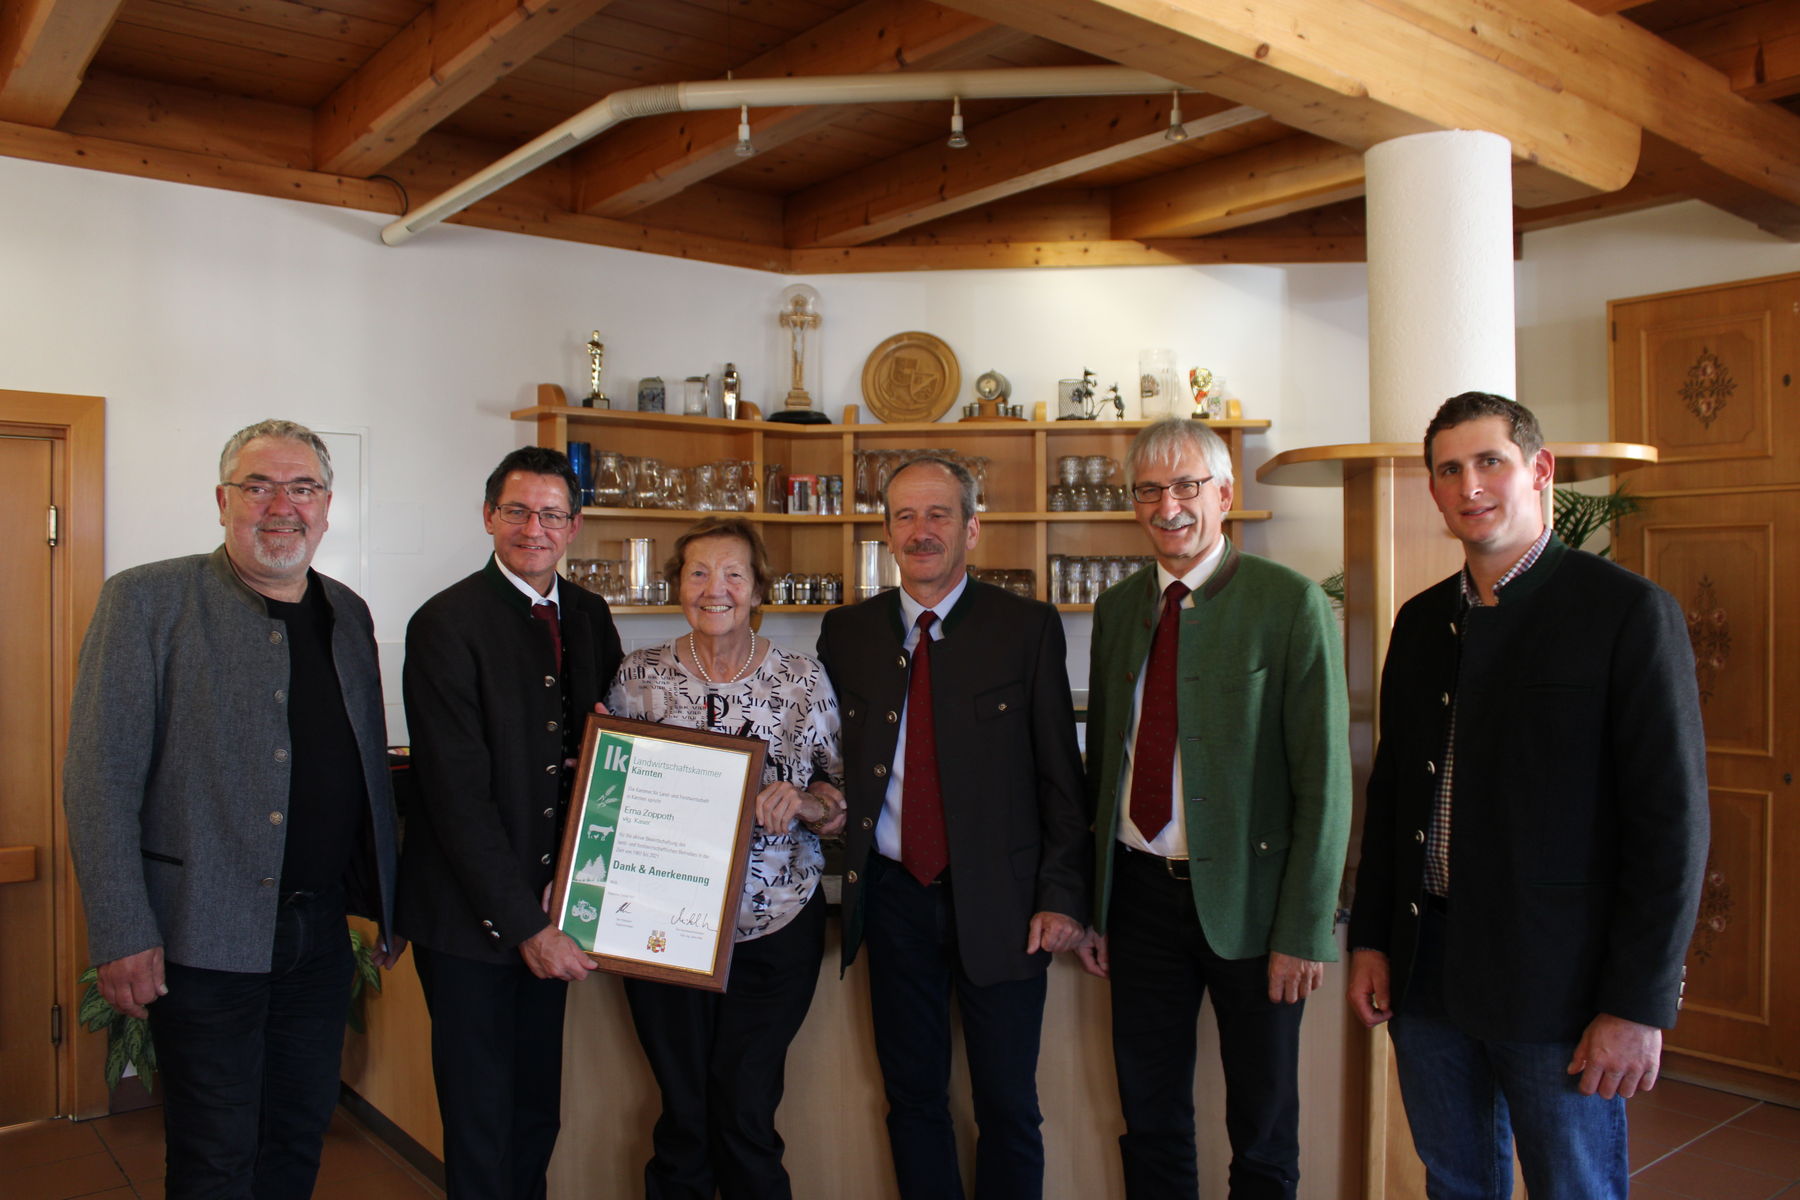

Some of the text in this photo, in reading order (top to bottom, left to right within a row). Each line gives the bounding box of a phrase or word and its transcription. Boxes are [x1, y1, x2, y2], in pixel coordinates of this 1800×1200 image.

[633, 756, 722, 778] Landwirtschaftskammer
[642, 808, 675, 821] Zoppoth
[613, 860, 710, 887] Dank & Anerkennung
